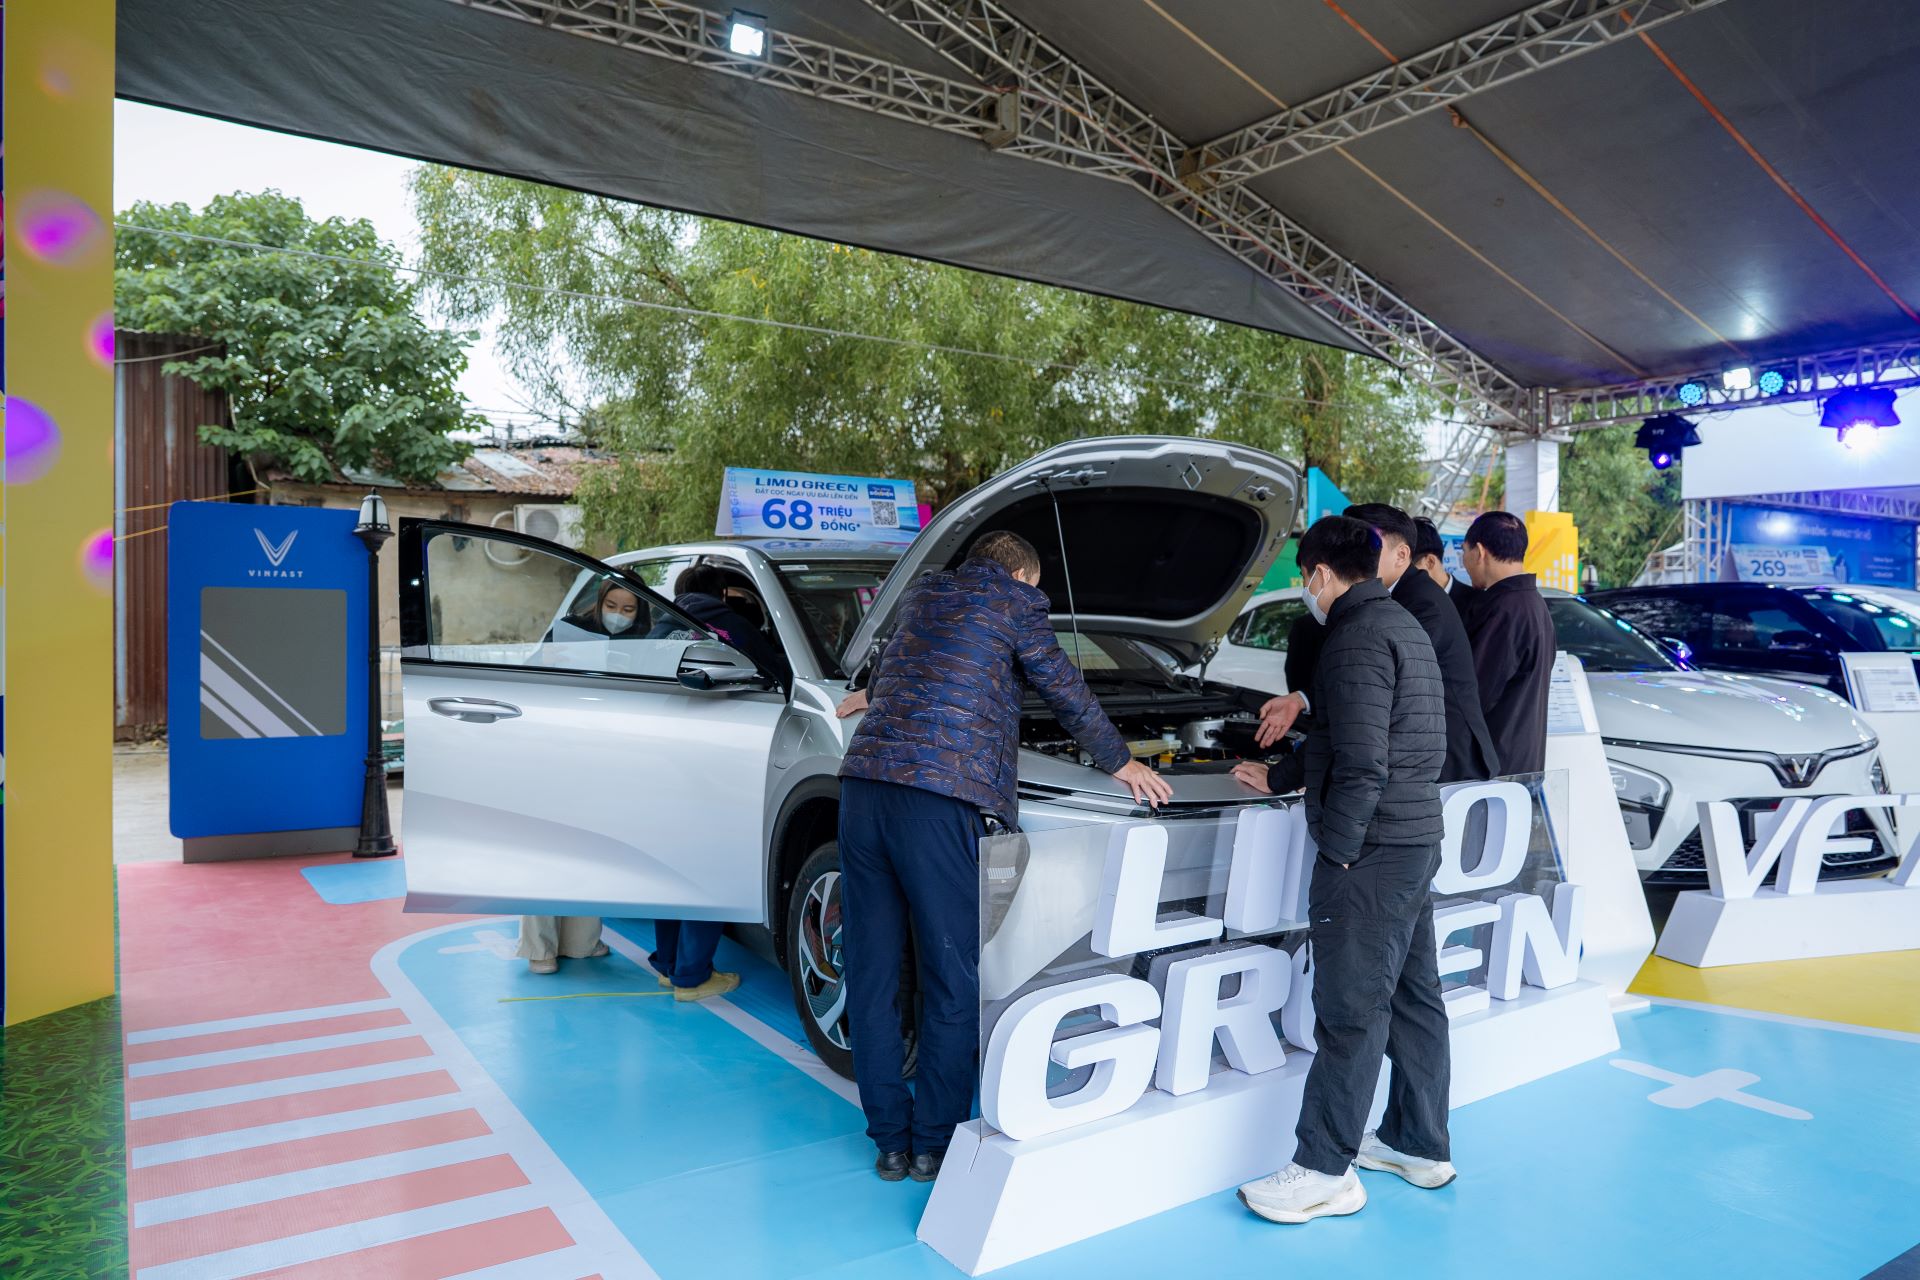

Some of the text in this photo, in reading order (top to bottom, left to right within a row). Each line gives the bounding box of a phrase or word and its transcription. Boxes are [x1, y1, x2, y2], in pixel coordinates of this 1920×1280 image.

[755, 477, 858, 492] LIMO GREEN
[762, 498, 813, 530] 68
[818, 505, 853, 519] TRIỆU
[248, 569, 304, 578] VINFAST
[1750, 559, 1786, 577] 269
[1091, 780, 1533, 958] LIO
[982, 882, 1585, 1140] GREN
